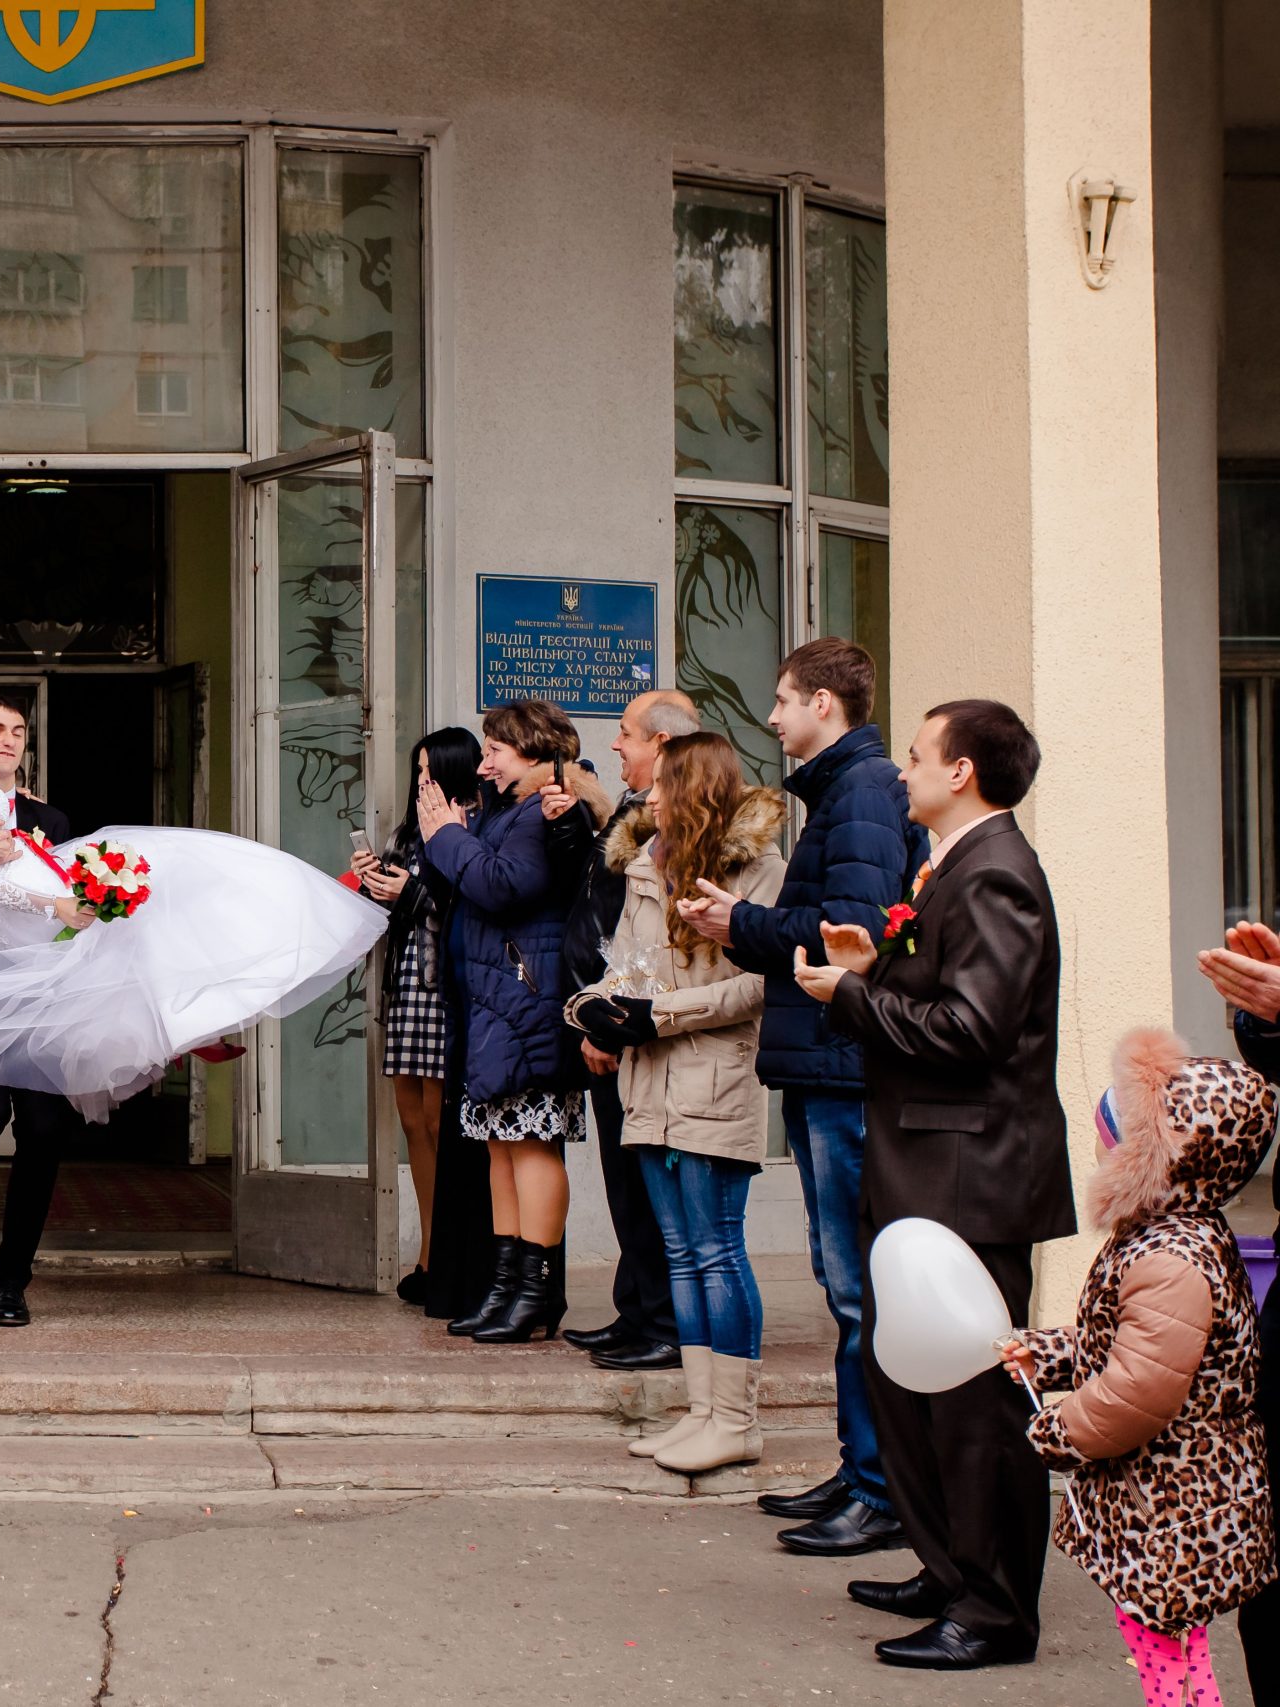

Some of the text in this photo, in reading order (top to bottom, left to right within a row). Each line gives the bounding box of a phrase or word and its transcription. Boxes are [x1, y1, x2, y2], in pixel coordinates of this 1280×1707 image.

[515, 619, 625, 632] МІНІСТЕРСТВО ЮСТИЦІЇ УКРАЇНИ
[556, 614, 583, 622] УКРАЇНА
[485, 632, 652, 651] ВІДДІЛ РЕЄСТРАЦІЇ АКТІВ
[502, 646, 636, 663] ЦИВІЛЬНОГО СТАНУ
[489, 660, 625, 677] ПО МІСТУ ХАРКОВУ
[487, 674, 652, 691] ХАРКІВСЬКОГО МІСЬКОГО
[495, 688, 580, 703] УПРАВЛІННЯ
